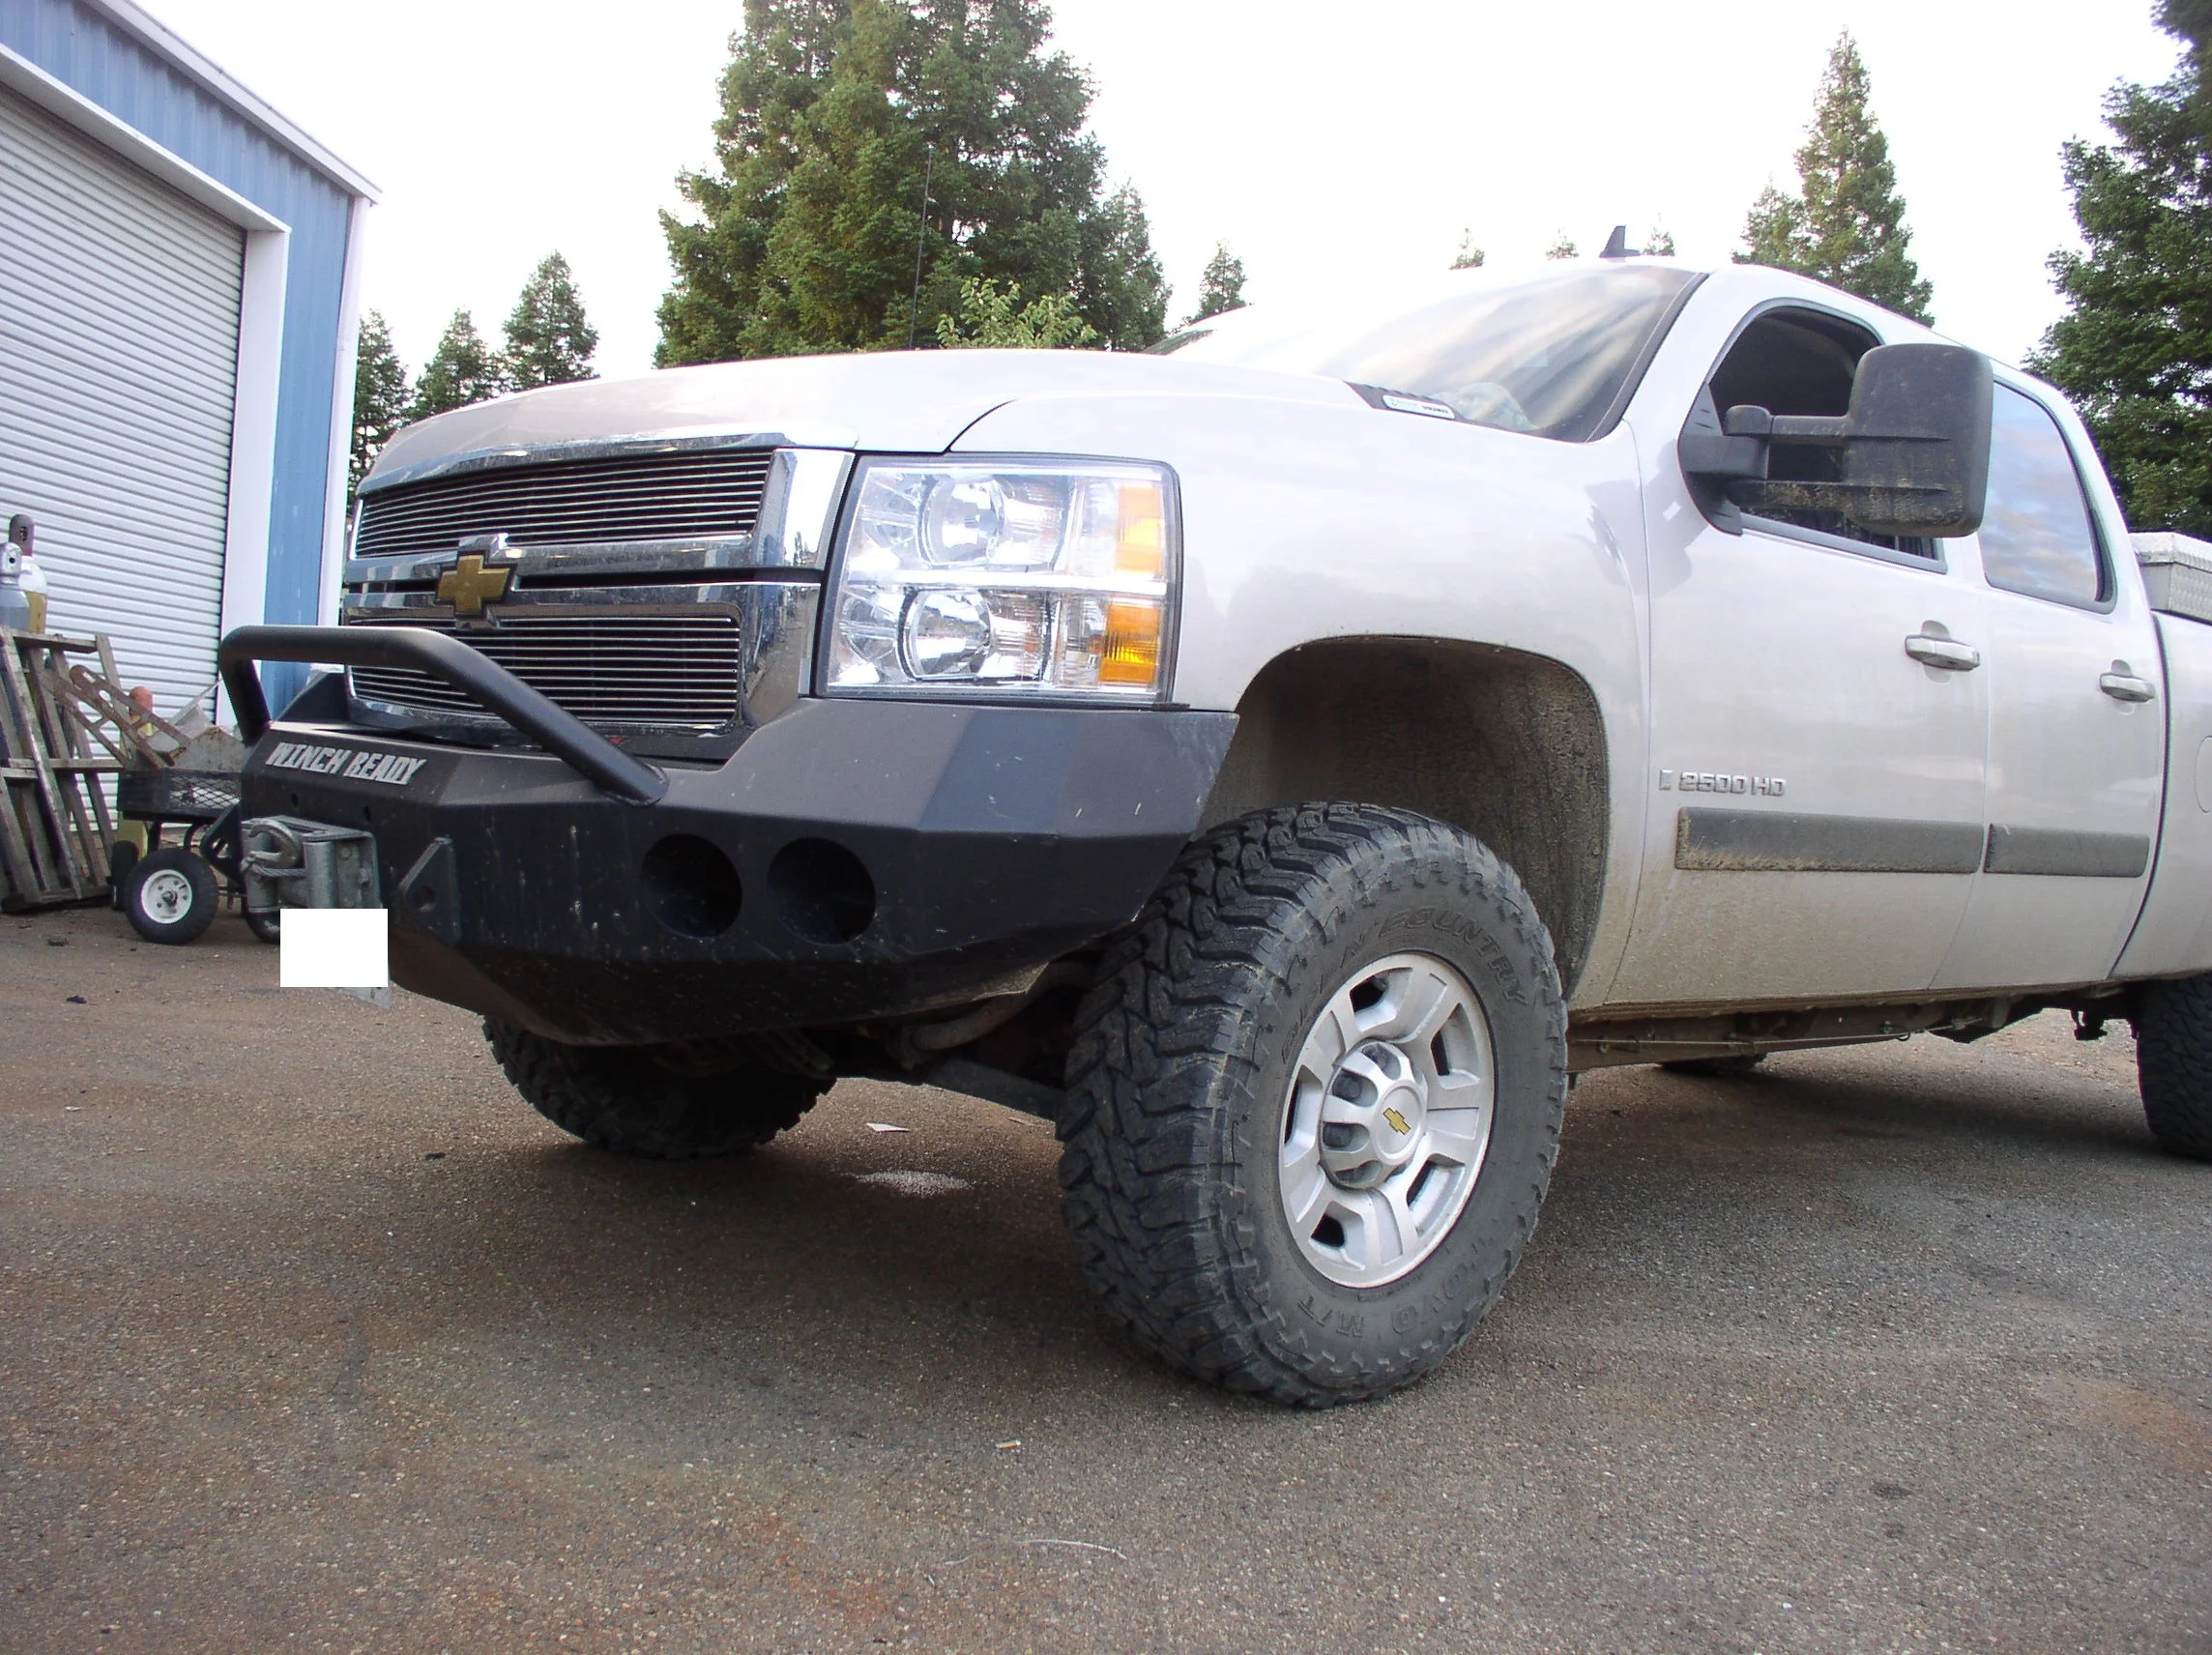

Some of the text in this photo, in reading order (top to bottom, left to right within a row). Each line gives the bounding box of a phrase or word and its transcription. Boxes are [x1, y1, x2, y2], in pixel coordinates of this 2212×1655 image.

[266, 742, 426, 785] WINCH READY
[1679, 771, 1787, 798] 2500 HD
